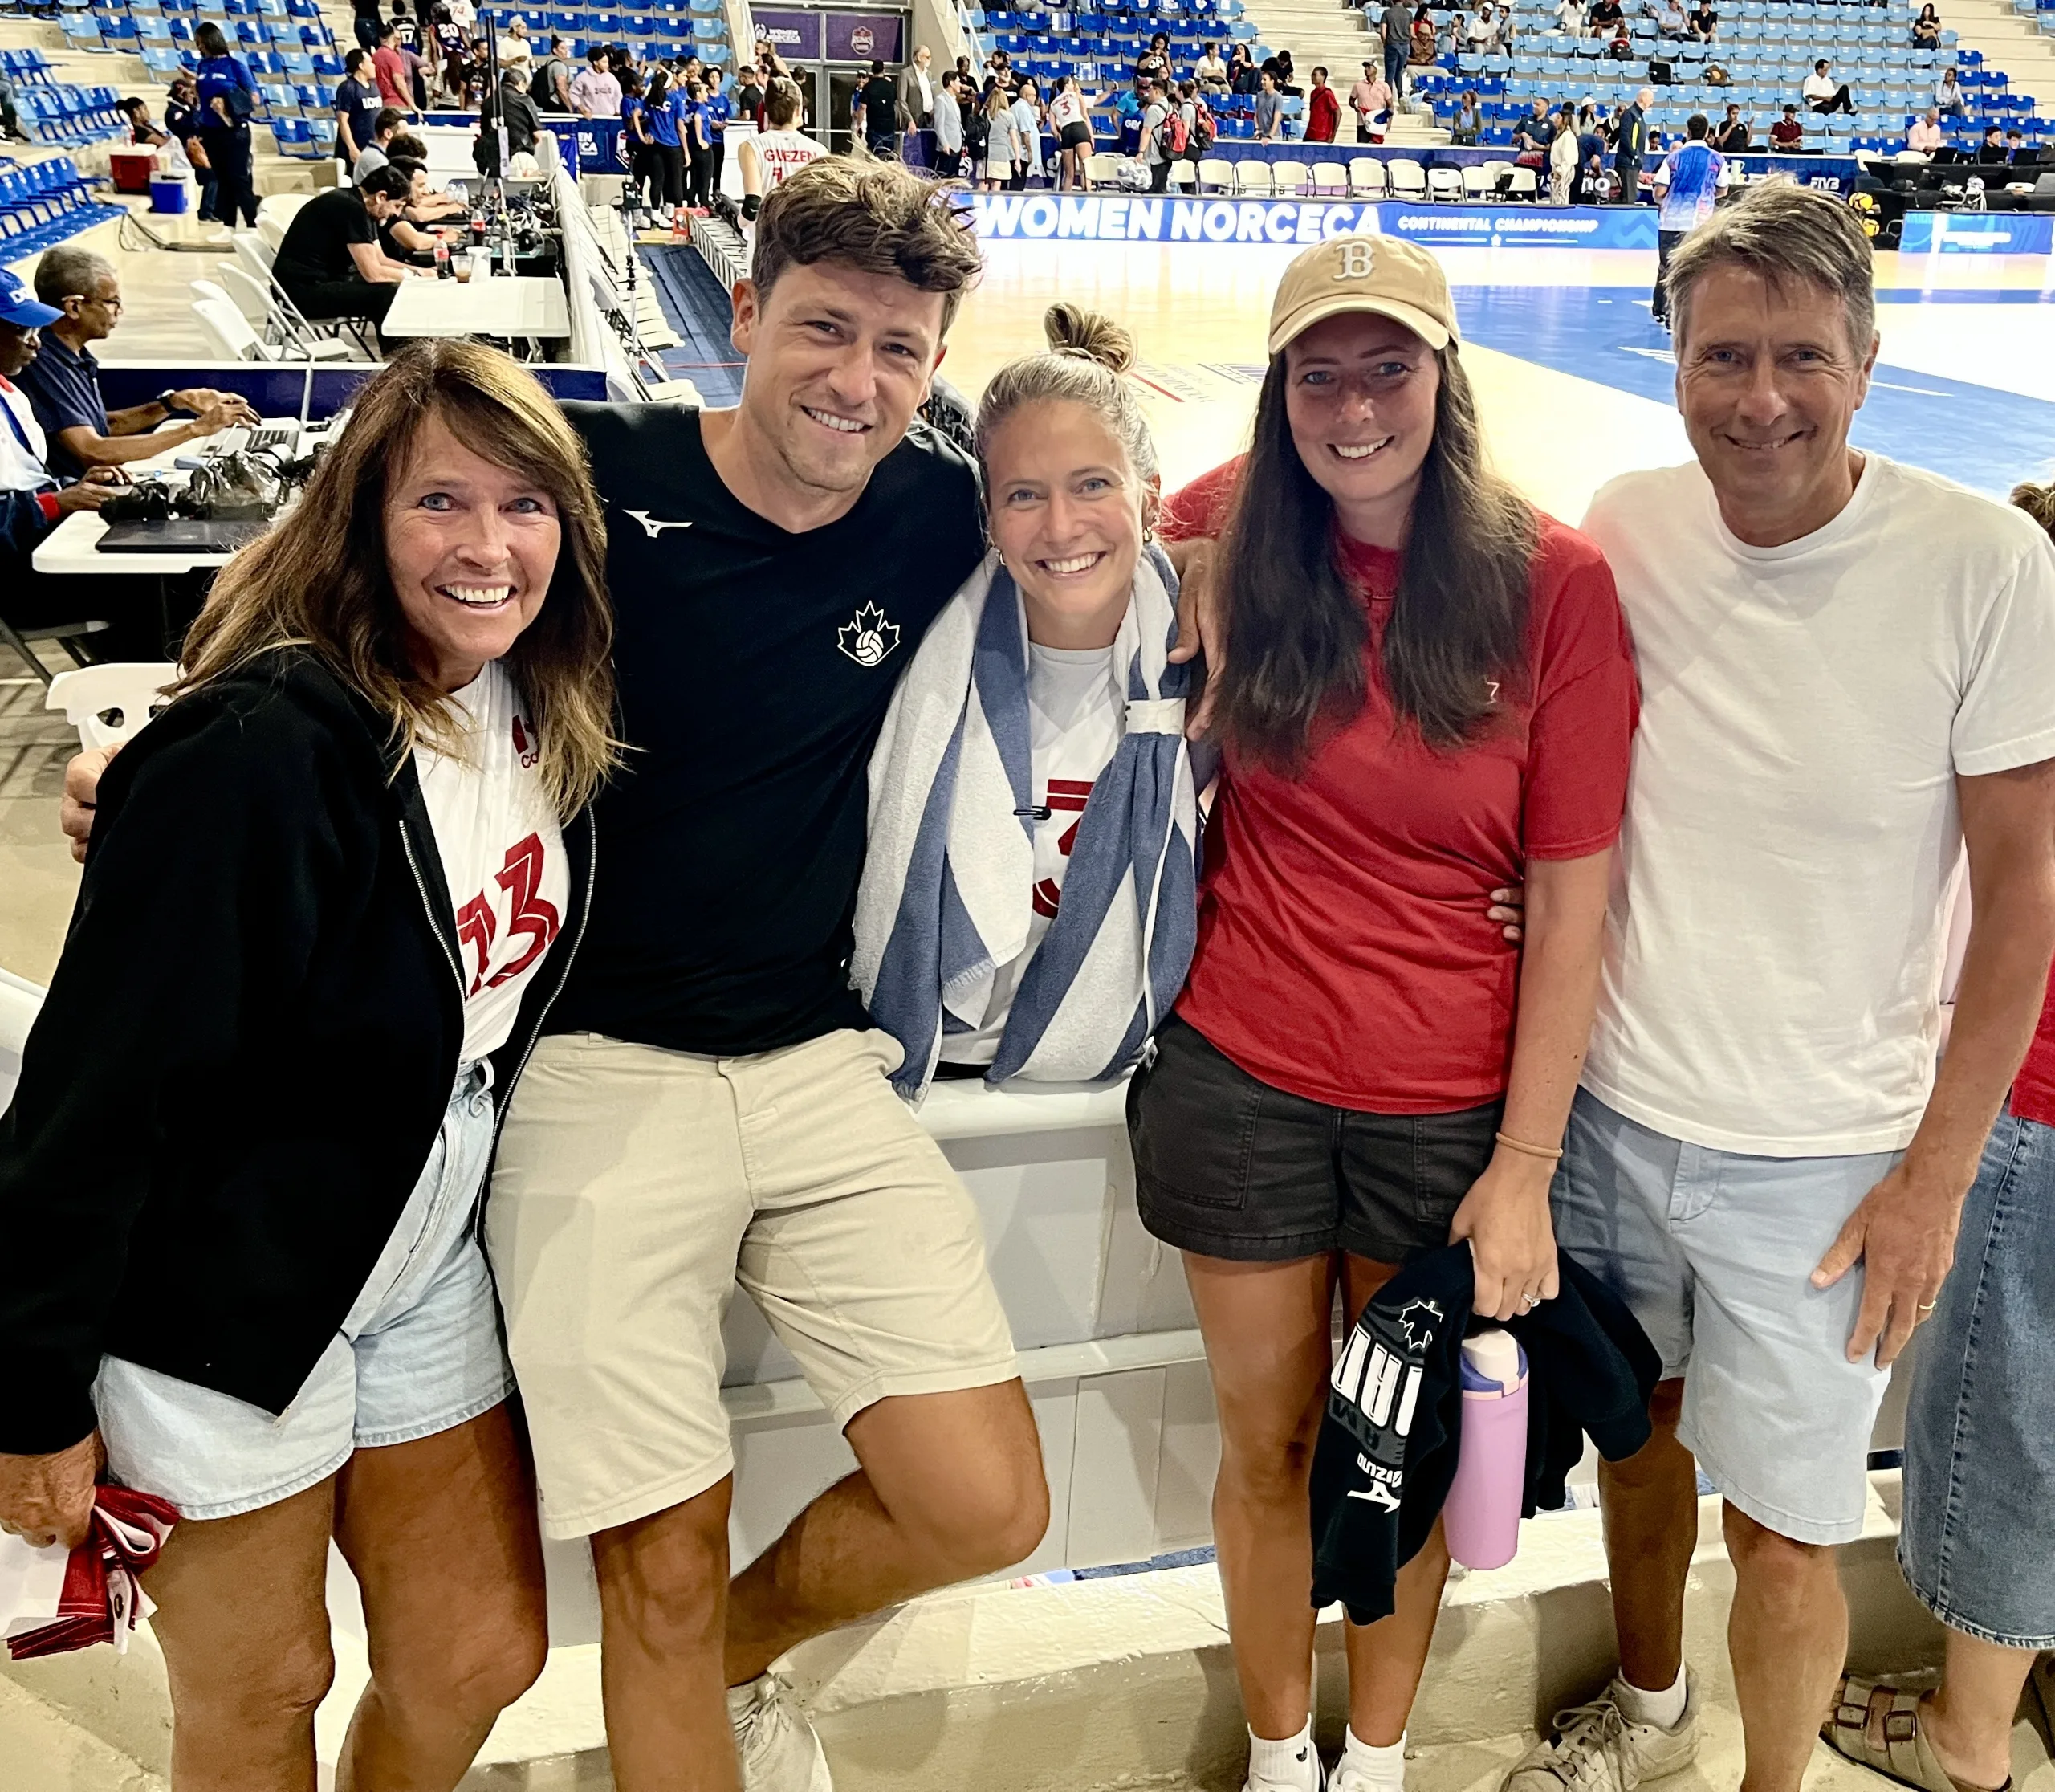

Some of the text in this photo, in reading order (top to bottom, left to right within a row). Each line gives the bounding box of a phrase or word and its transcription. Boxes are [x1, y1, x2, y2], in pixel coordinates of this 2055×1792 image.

[438, 23, 459, 38] 20
[1811, 177, 1840, 190] FIVB
[973, 195, 1380, 242] WOMEN NORCECA
[1398, 216, 1598, 233] CONTINENTAL CHAMPIONSHIP
[1333, 240, 1375, 281] B
